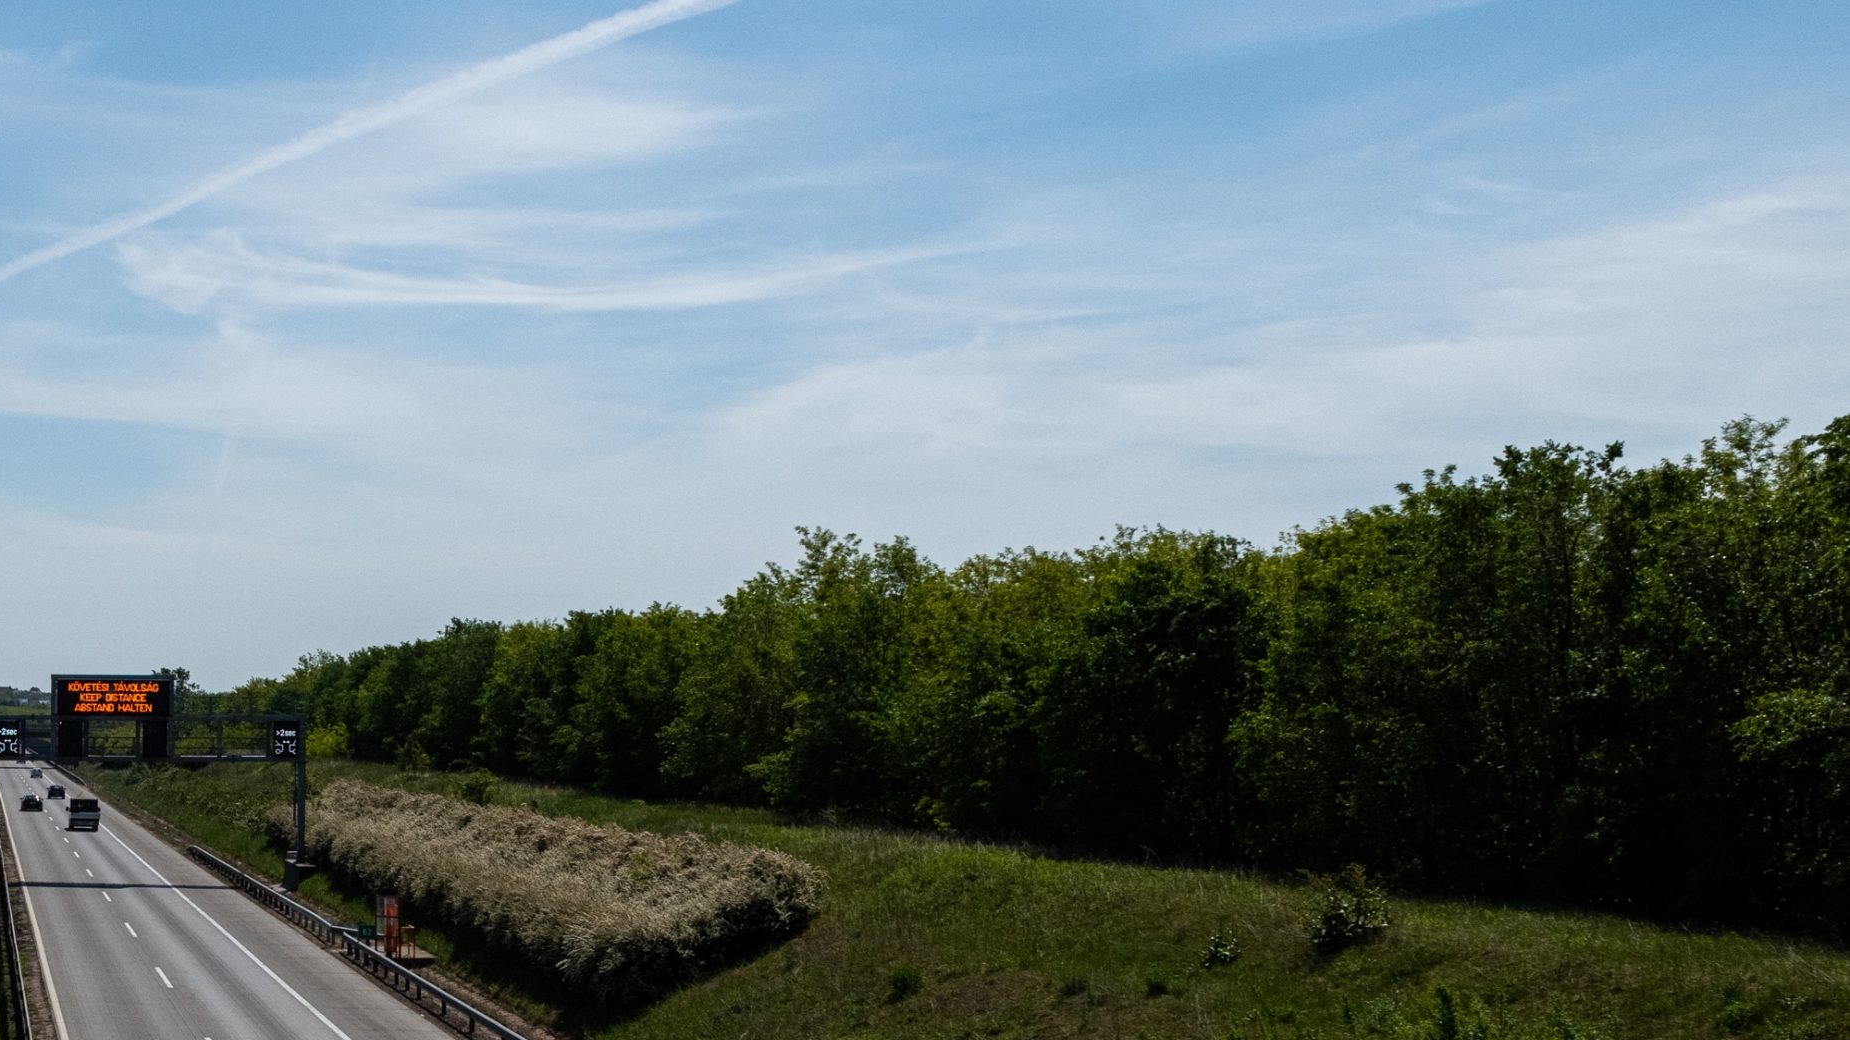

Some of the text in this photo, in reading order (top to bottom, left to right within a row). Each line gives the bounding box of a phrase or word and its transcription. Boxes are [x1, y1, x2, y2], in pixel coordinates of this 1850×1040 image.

[68, 681, 160, 692] KÖVETÉSI TÁVOLSÁG
[80, 693, 147, 702] KEEP DISTANCE
[74, 703, 153, 713] ABSTAND HALTEN
